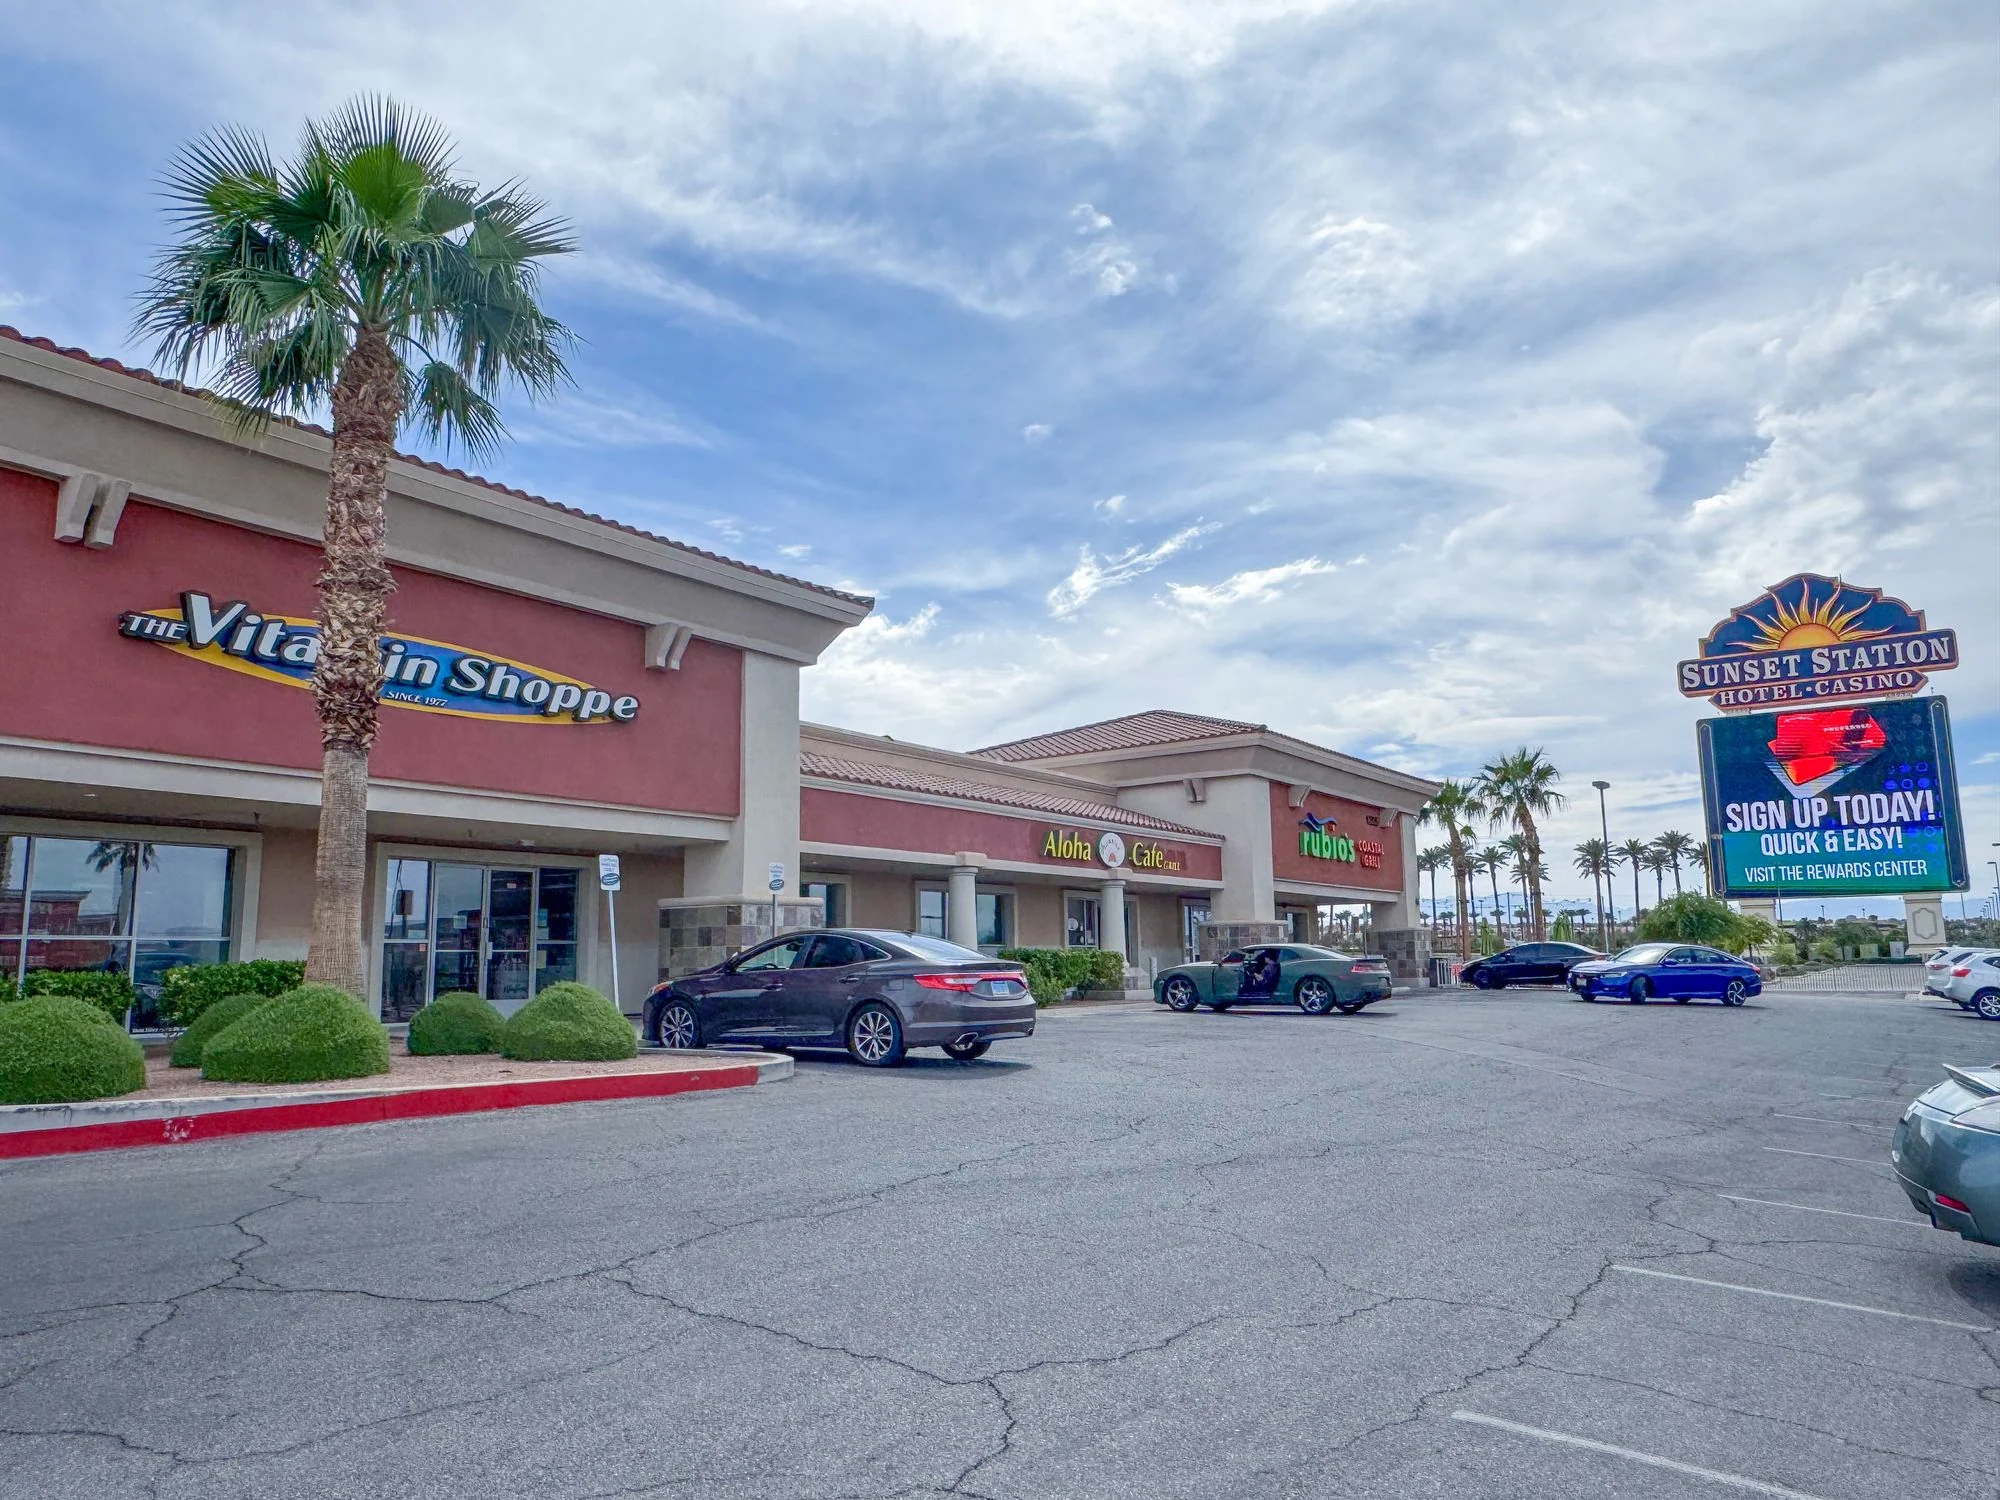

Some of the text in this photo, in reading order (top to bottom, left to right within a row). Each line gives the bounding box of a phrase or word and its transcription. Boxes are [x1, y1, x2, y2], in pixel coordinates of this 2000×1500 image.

[128, 593, 640, 720] THE Vitain Shoppe
[1681, 637, 1951, 689] SUNSET STATION
[386, 691, 448, 706] SINCE 1977
[1725, 789, 1936, 832] SIGN UP TODAY!
[1043, 829, 1092, 861] Aloha
[1358, 840, 1385, 855] COASTAL
[1760, 826, 1904, 857] QUICK & EASY!
[1363, 854, 1381, 868] GRILL
[1744, 859, 1928, 883] VISIT THE REWARDS CENTER
